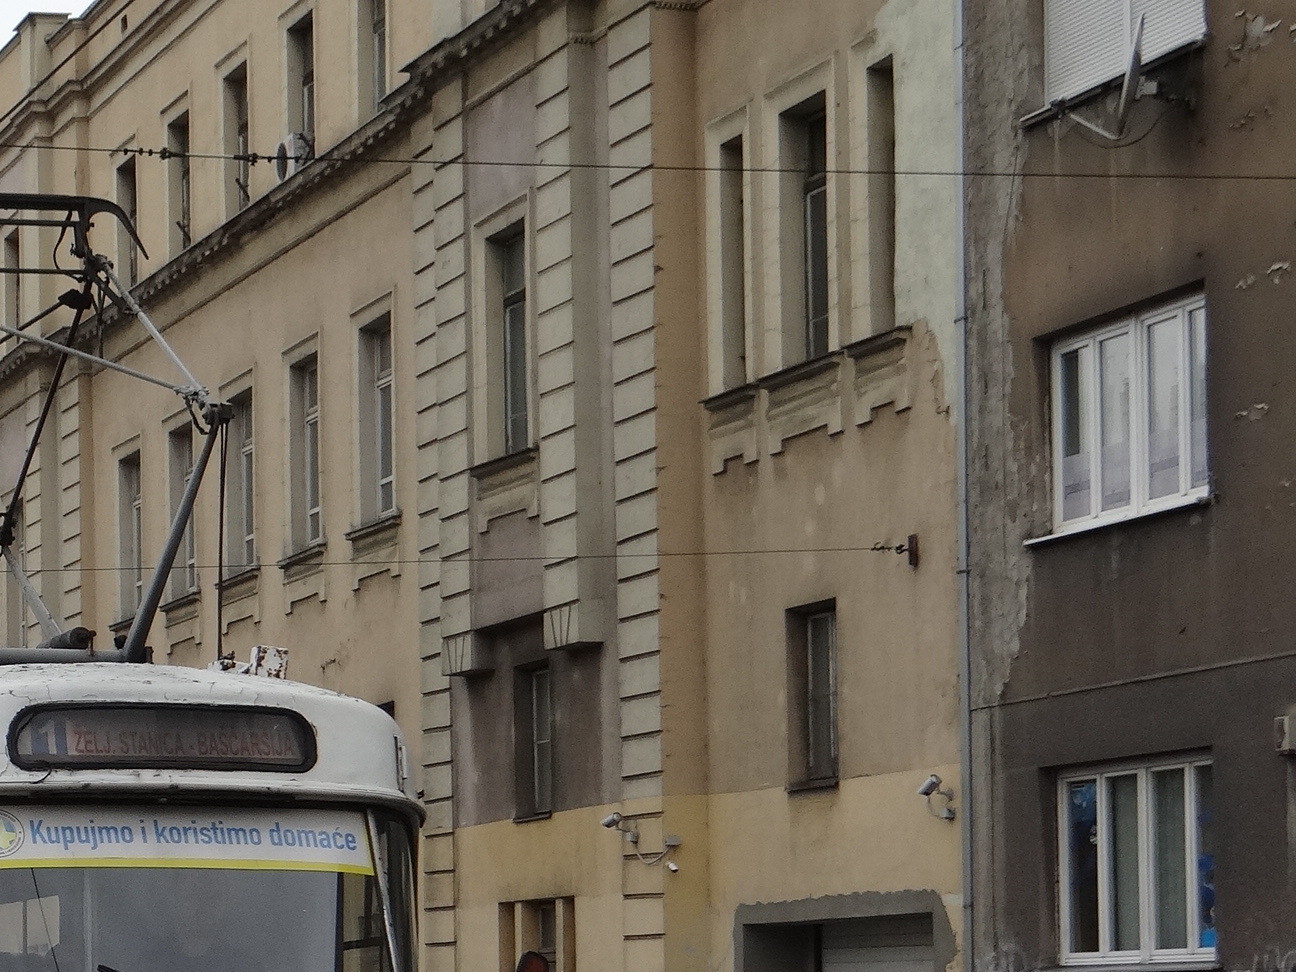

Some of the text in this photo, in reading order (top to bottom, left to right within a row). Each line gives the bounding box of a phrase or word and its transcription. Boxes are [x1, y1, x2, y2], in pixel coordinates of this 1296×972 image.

[37, 719, 57, 755] 1
[118, 730, 185, 755] STANICA
[29, 819, 134, 850] Kupujmo
[138, 818, 148, 844] i
[153, 819, 262, 846] koristimo
[269, 821, 358, 851] domaće
